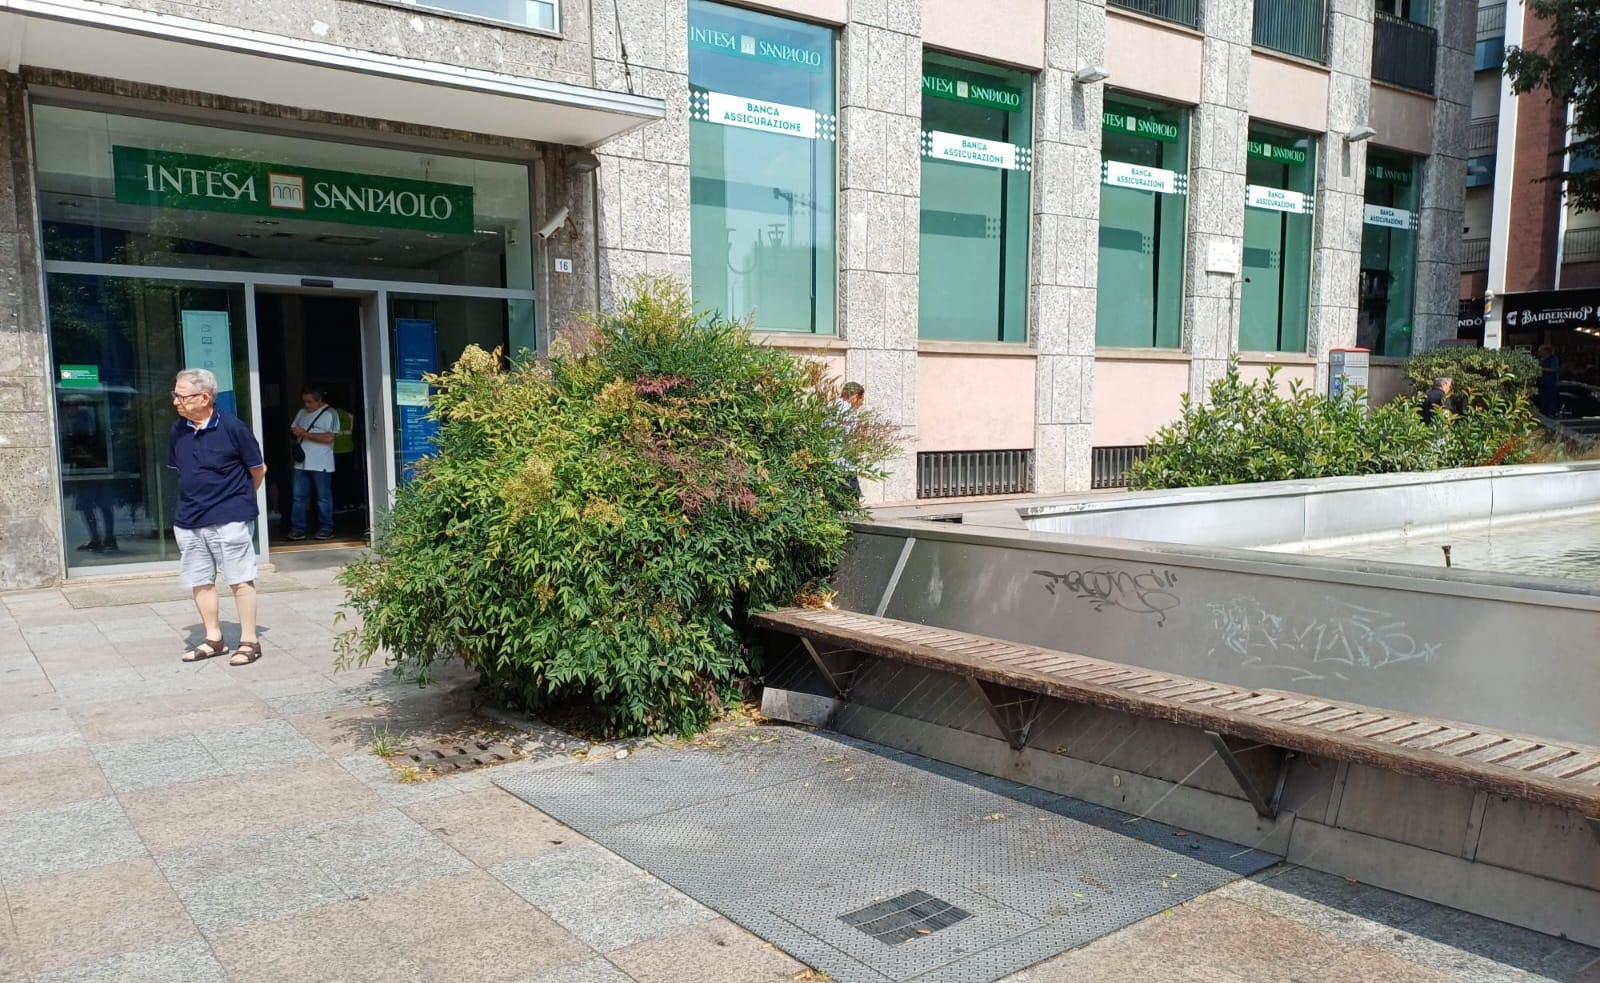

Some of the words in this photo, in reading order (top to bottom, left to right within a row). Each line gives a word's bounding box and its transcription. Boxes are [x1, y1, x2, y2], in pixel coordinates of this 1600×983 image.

[690, 26, 736, 50] INTESA
[760, 40, 821, 66] SANPAOLO
[922, 75, 953, 94] NTESA
[971, 85, 1020, 106] SANPAOLO
[747, 103, 780, 116] BANCA
[724, 112, 801, 132] ASSICURAZIONE
[1137, 119, 1177, 138] SANPAOLO
[962, 139, 988, 151] BANCA
[943, 148, 1004, 164] ASSICURAZIONE
[1273, 146, 1305, 162] SANPAOLO
[1131, 168, 1152, 177] BANCA
[1117, 176, 1165, 189] ASSICURAZIONE
[145, 163, 258, 202] INTESA
[313, 182, 452, 220] SANPAOLO
[1268, 190, 1285, 199] BANCA
[559, 261, 569, 271] 16
[1458, 316, 1482, 327] NDÒ
